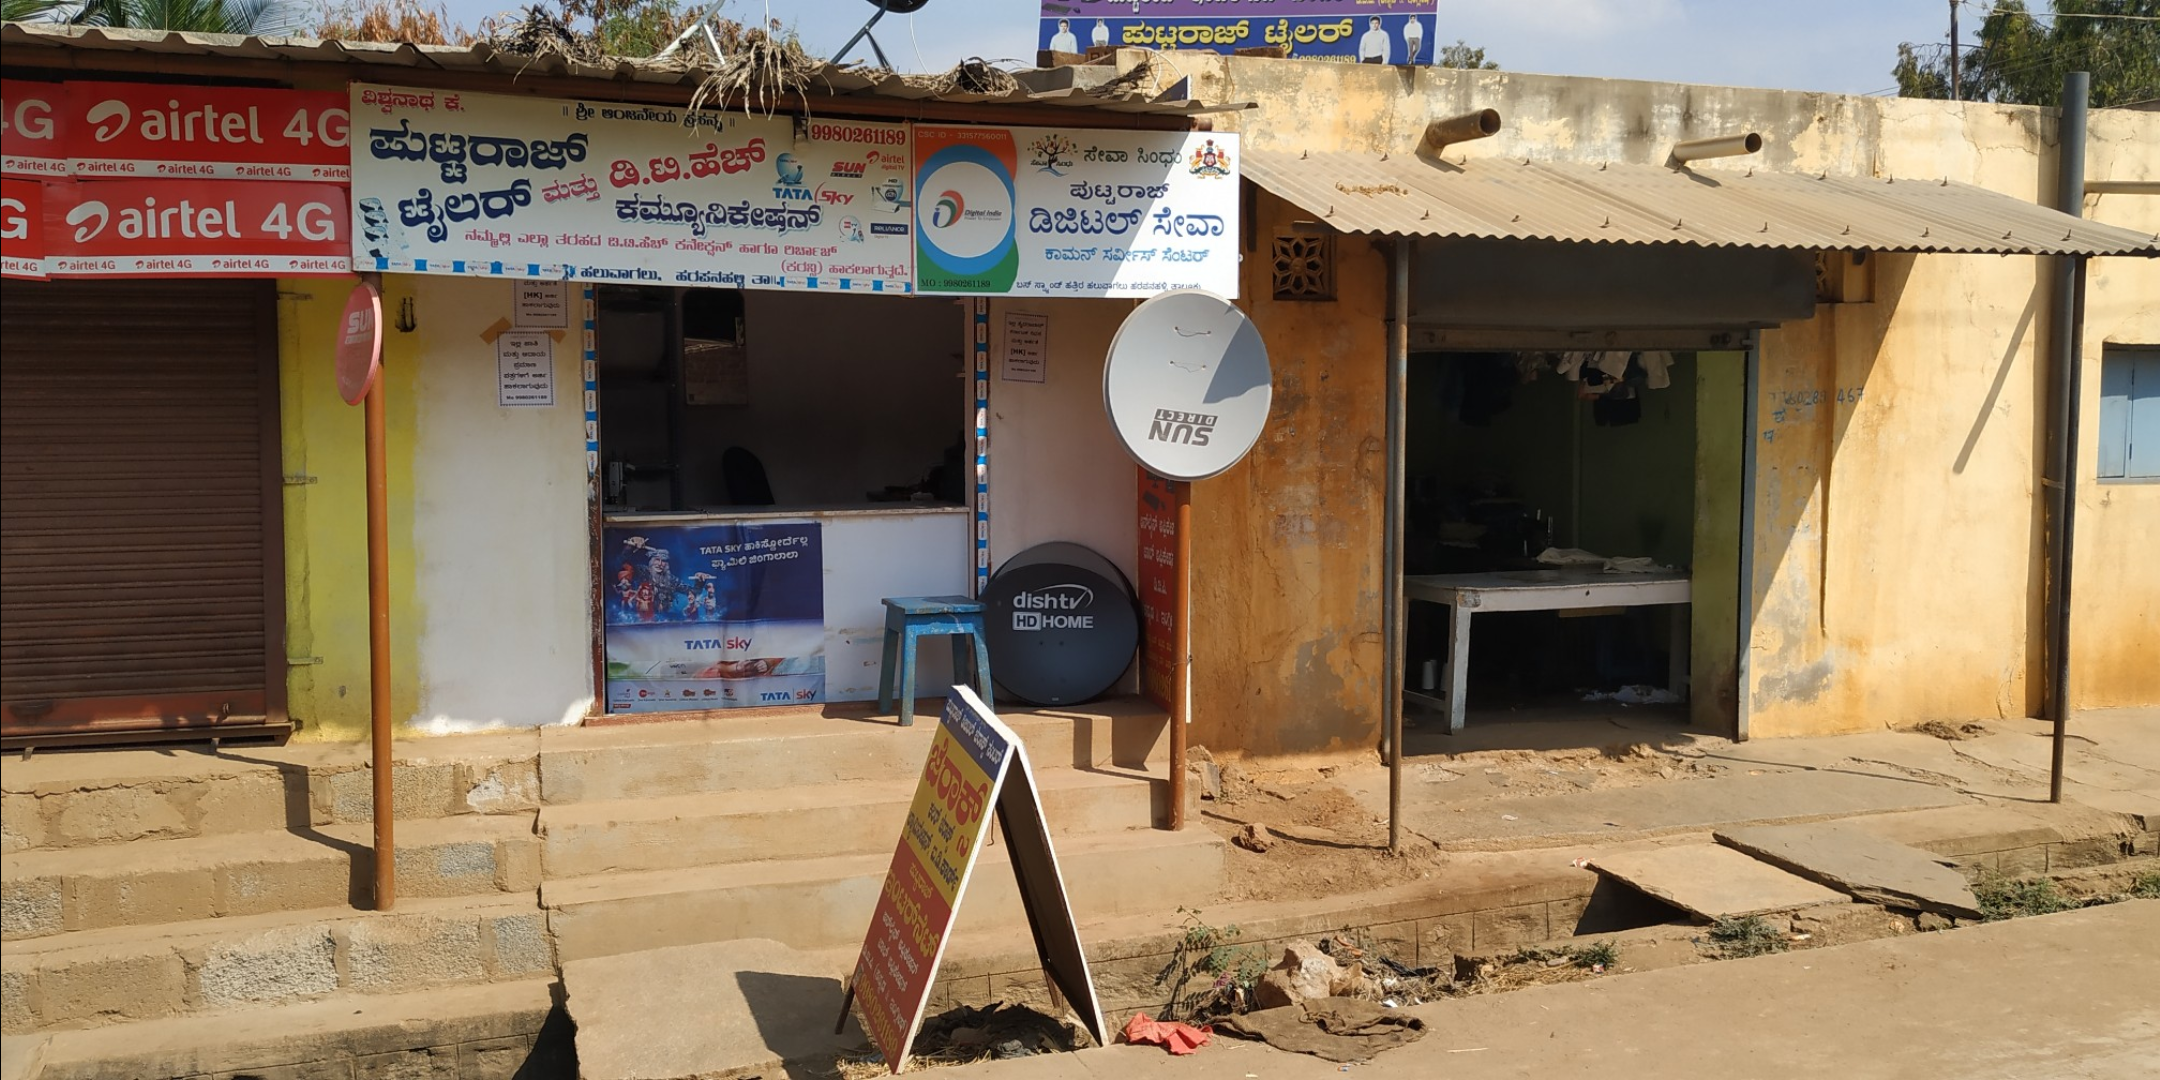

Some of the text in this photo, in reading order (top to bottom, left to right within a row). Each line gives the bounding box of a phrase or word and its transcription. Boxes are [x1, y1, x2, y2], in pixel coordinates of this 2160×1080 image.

[1122, 18, 1354, 54] ಪುಟ್ಟರಾಜ್ ಟೈಲರ್
[361, 89, 465, 115] ವಿಶ್ವನಾಥ ಕೆ.
[0, 99, 55, 140] G
[575, 101, 595, 121] ಶ್ರೀ
[602, 108, 677, 124] ಆಂಜನೇಯ
[140, 99, 350, 148] airtel 4G
[810, 124, 906, 146] 9980261189
[369, 118, 589, 185] ಪುಟ್ಟರಾಜ್
[881, 153, 905, 164] airtel
[1084, 145, 1128, 163] ಸೇವಾ
[17, 160, 66, 172] airtel 4G
[88, 160, 135, 172] airtel 4G
[167, 163, 215, 175] airtel 4G
[609, 137, 766, 188] ಡಿ.ಟಿ.ಹೆಚ್
[831, 161, 867, 174] SUN
[246, 165, 292, 177] airtel 4G
[322, 168, 350, 178] airtel
[541, 173, 602, 203] ಮತ್ತು
[772, 187, 815, 201] TATA
[1070, 180, 1170, 205] ಪುಟ್ಟರಾಜ್
[398, 178, 532, 244] ಟೈಲರ್
[615, 193, 823, 238] ಕಮ್ಯೂನಿಕೇಷನ್
[965, 209, 984, 218] Digital
[119, 196, 336, 242] airtel 4G
[1029, 205, 1224, 237] ಡಿಜಿಟಲ್ ಸೇವಾ
[874, 225, 906, 233] RELIANCE
[465, 229, 511, 249] ನಮ್ಮಲ್ಲಿ
[518, 233, 549, 249] ಎಲ್ಲಾ
[555, 233, 601, 247] ತರಹದ
[739, 243, 778, 255] ಹಾಗೂ
[1045, 246, 1098, 262] ಕಾಮನ್
[1162, 247, 1210, 263] ಸೆಂಟರ್
[22, 262, 37, 272] 4G
[69, 260, 116, 270] airtel 4G
[147, 259, 192, 270] airtel 4G
[223, 259, 269, 269] airtel 4G
[300, 259, 346, 270] airtel 4G
[829, 264, 908, 279] ಹಾಕಲಾಗುತ್ತದೆ.
[675, 269, 745, 290] ಹರಪನಹಳ್ಳಿ
[944, 279, 991, 289] 9980261189
[1017, 281, 1031, 289] ಬಸ್
[1065, 281, 1083, 292] ಹತ್ತಿರ
[1157, 409, 1215, 426] DIRECT
[1148, 420, 1214, 447] SUN
[700, 545, 724, 555] TATA
[725, 543, 742, 553] SKY
[749, 550, 799, 565] ಜಿಂಗಾಲಾಲಾ
[1016, 615, 1094, 629] HD HOME
[684, 636, 752, 651] TATA sky
[760, 689, 817, 701] TATA sky
[925, 738, 988, 857] ಜೆರಾಕ್ಸ್
[859, 975, 898, 1059] 9980261189
